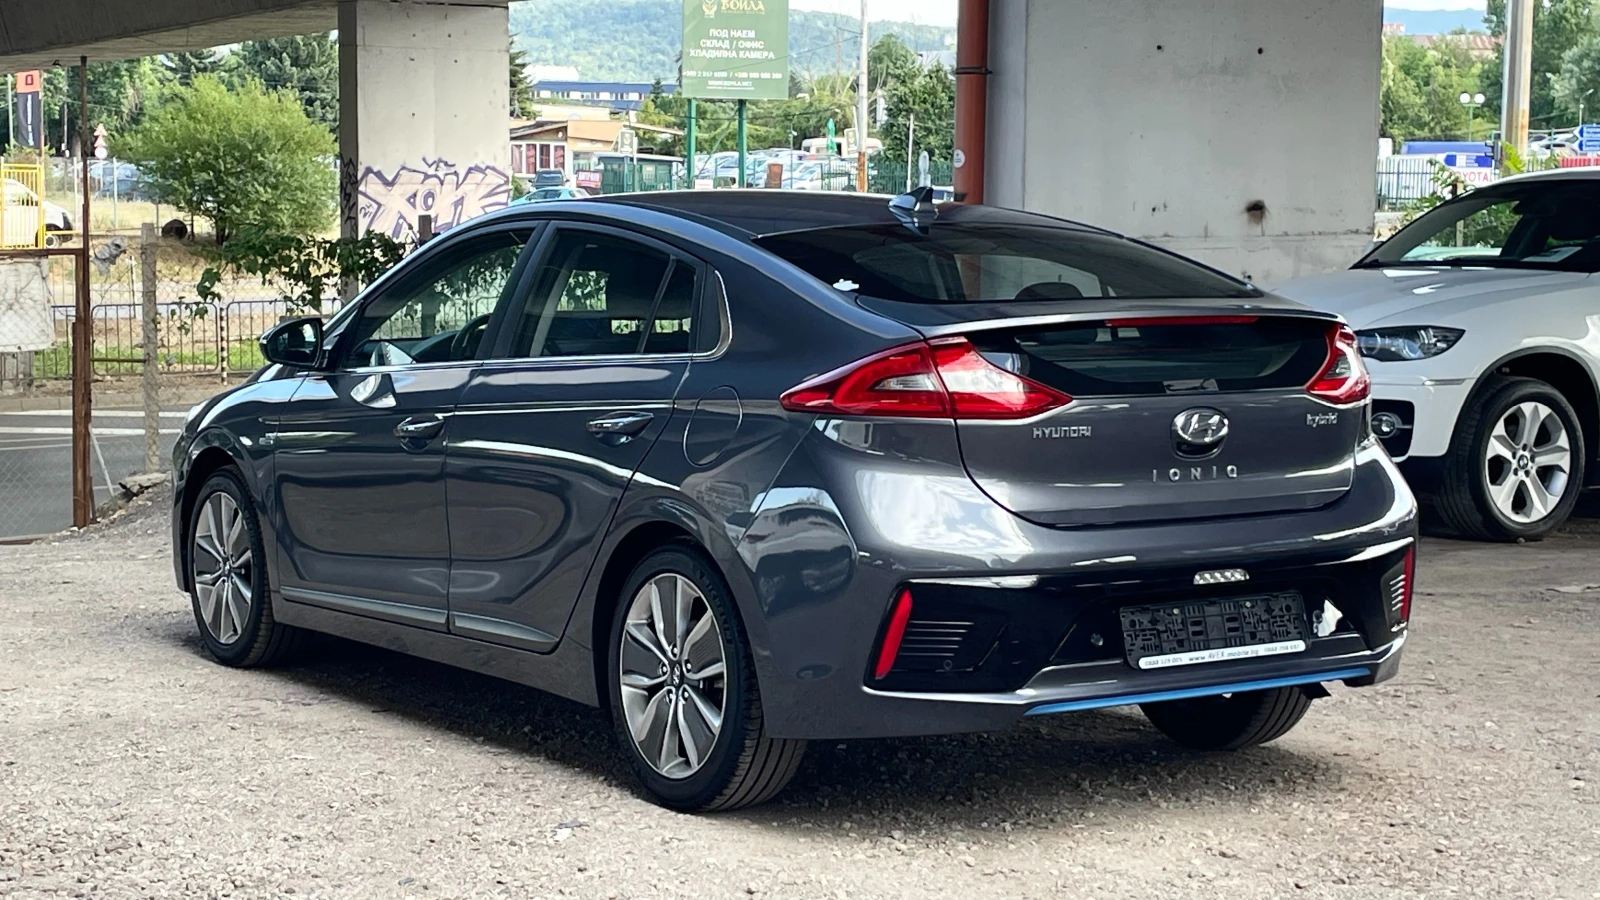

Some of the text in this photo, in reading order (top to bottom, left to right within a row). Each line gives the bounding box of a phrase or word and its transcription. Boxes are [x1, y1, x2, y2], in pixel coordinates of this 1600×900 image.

[709, 28, 756, 38] ПОД НАЕМ
[700, 39, 730, 49] СКЛАД
[738, 40, 765, 49] ОФИС
[738, 50, 775, 59] КАМЕРА
[1306, 412, 1338, 428] hybrid
[1032, 425, 1092, 439] HYUNDAI
[1152, 464, 1238, 483] IONIQ
